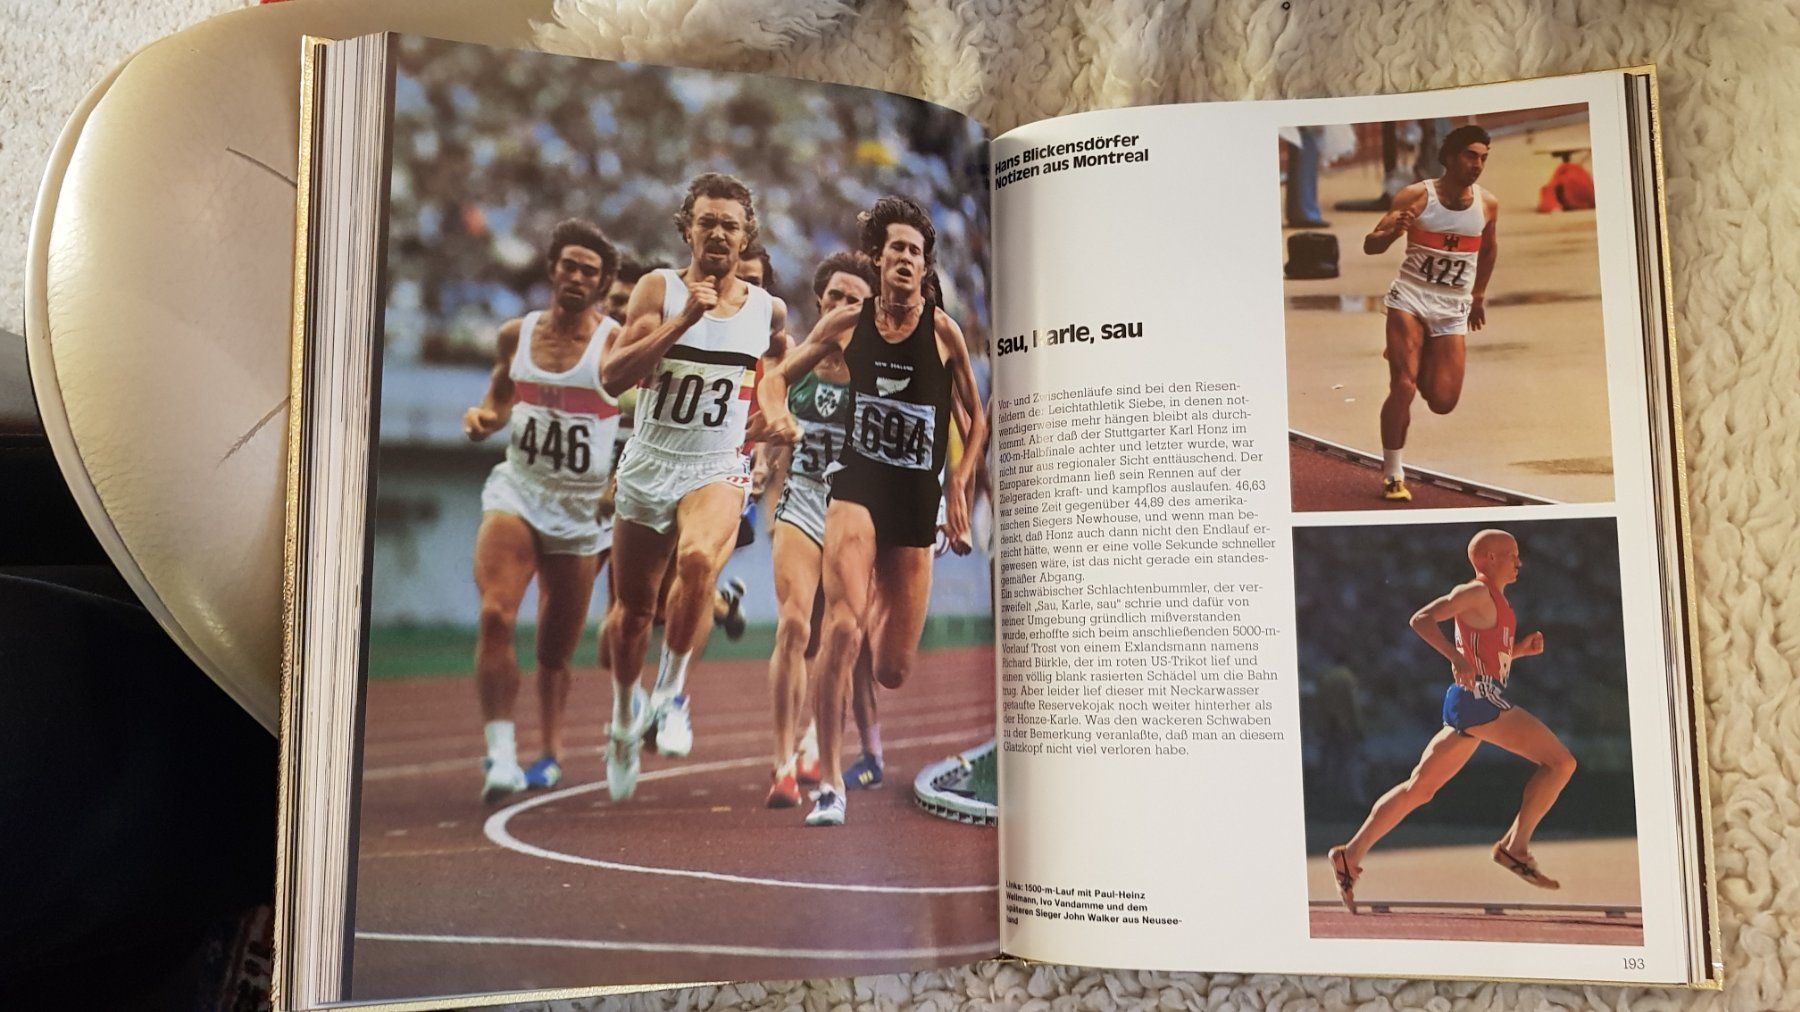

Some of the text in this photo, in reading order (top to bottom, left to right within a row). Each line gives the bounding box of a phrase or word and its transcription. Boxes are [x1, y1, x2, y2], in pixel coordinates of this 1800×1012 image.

[994, 134, 1140, 176] Hans Blickensdörfer
[995, 148, 1150, 191] Notizen aus Montreal
[1419, 255, 1467, 288] 422
[997, 335, 1028, 357] Sau,
[1100, 321, 1143, 340] sau
[1116, 383, 1141, 396] sind
[1144, 383, 1164, 394] bei
[1168, 382, 1191, 393] den
[1195, 381, 1240, 392] Riesen-
[652, 370, 734, 428] 103
[1048, 395, 1249, 415] Leichtathletik Siebe, denen not-
[1071, 408, 1251, 427] mehr hängen bleibt als durch-
[861, 404, 926, 465] 694
[1055, 423, 1228, 442] daß der Stuttgarter Karl Honz
[519, 416, 591, 474] 446
[1078, 442, 1115, 454] achter
[1119, 440, 1142, 452] und
[1145, 440, 1183, 451] letzter
[1186, 437, 1228, 450] wurde,
[1056, 456, 1116, 472] regionaler
[1119, 454, 1150, 466] Sicht
[1152, 451, 1236, 465] enttäuschend.
[1240, 451, 1263, 462] Der
[1094, 469, 1115, 482] ließ
[1119, 469, 1144, 480] sein
[1147, 468, 1195, 479] Rennen
[1197, 466, 1217, 477] auf
[1053, 486, 1083, 498] kraft-
[1111, 482, 1166, 497] kampflos
[1169, 480, 1231, 493] auslaufen.
[1235, 479, 1266, 492] 46,63
[1041, 501, 1063, 513] Zeit
[1064, 498, 1130, 514] gegenüber
[1133, 496, 1164, 509] 44,89
[1166, 496, 1190, 507] des
[1194, 494, 1247, 506] amerika-
[1032, 510, 1234, 529] Siegers Newhouse, und wenn man
[1045, 529, 1073, 541] Honz
[1074, 527, 1105, 539] auch
[1106, 526, 1138, 538] dann
[1140, 525, 1171, 536] nicht
[1175, 524, 1199, 535] den
[1202, 523, 1250, 535] Endlauf
[1052, 544, 1083, 554] wenn
[1102, 541, 1128, 552] eine
[1132, 539, 1164, 551] volle
[1165, 538, 1218, 550] Sekunde
[1221, 537, 1276, 549] schneller
[1040, 552, 1268, 569] wäre, ist das nicht gerade standes-
[1039, 571, 1084, 585] Abgang.
[1086, 582, 1209, 595] Schlachtenbummler,
[1213, 581, 1235, 593] der
[1061, 596, 1249, 611] Karle, schrie und dafür von
[1089, 612, 1146, 627] gründlich
[1150, 610, 1241, 623] mißverstanden
[1071, 627, 1095, 638] sich
[1098, 627, 1129, 638] beim
[1132, 625, 1229, 637] anschließenden
[1232, 625, 1280, 636] 5000-m-
[1030, 640, 1258, 653] Trost von einem Exlandsmann namens
[1034, 654, 1258, 669] Bürkle, der roten US-Trikot lief und
[1055, 670, 1087, 682] blank
[1090, 671, 1143, 681] rasierten
[1146, 670, 1196, 681] Schädel
[1247, 669, 1278, 680] Bahn
[1047, 685, 1080, 696] leider
[1083, 685, 1104, 696] lief
[1105, 685, 1144, 696] dieser
[1148, 685, 1166, 696] mit
[1170, 684, 1259, 696] Neckarwasser
[1038, 699, 1251, 713] Reservekojak noch weiter hinterher
[1084, 714, 1110, 725] Was
[1113, 714, 1137, 725] den
[1141, 714, 1203, 725] wackeren
[1206, 714, 1271, 725] Schwaben
[1095, 729, 1161, 742] veranlaßte,
[1165, 729, 1188, 740] daß
[1192, 731, 1218, 740] man
[1239, 729, 1285, 740] diesem
[1046, 743, 1189, 755] nicht viel verloren habe.
[1024, 883, 1146, 900] 1500-m-Lauf mit Paul-Heinz
[1040, 896, 1053, 907] Ivo
[1054, 898, 1104, 910] Vandamme
[1106, 902, 1125, 912] und
[1127, 902, 1148, 912] dem
[1035, 907, 1182, 926] Sieger John Walker aus Neusee-
[1623, 957, 1645, 970] 193
